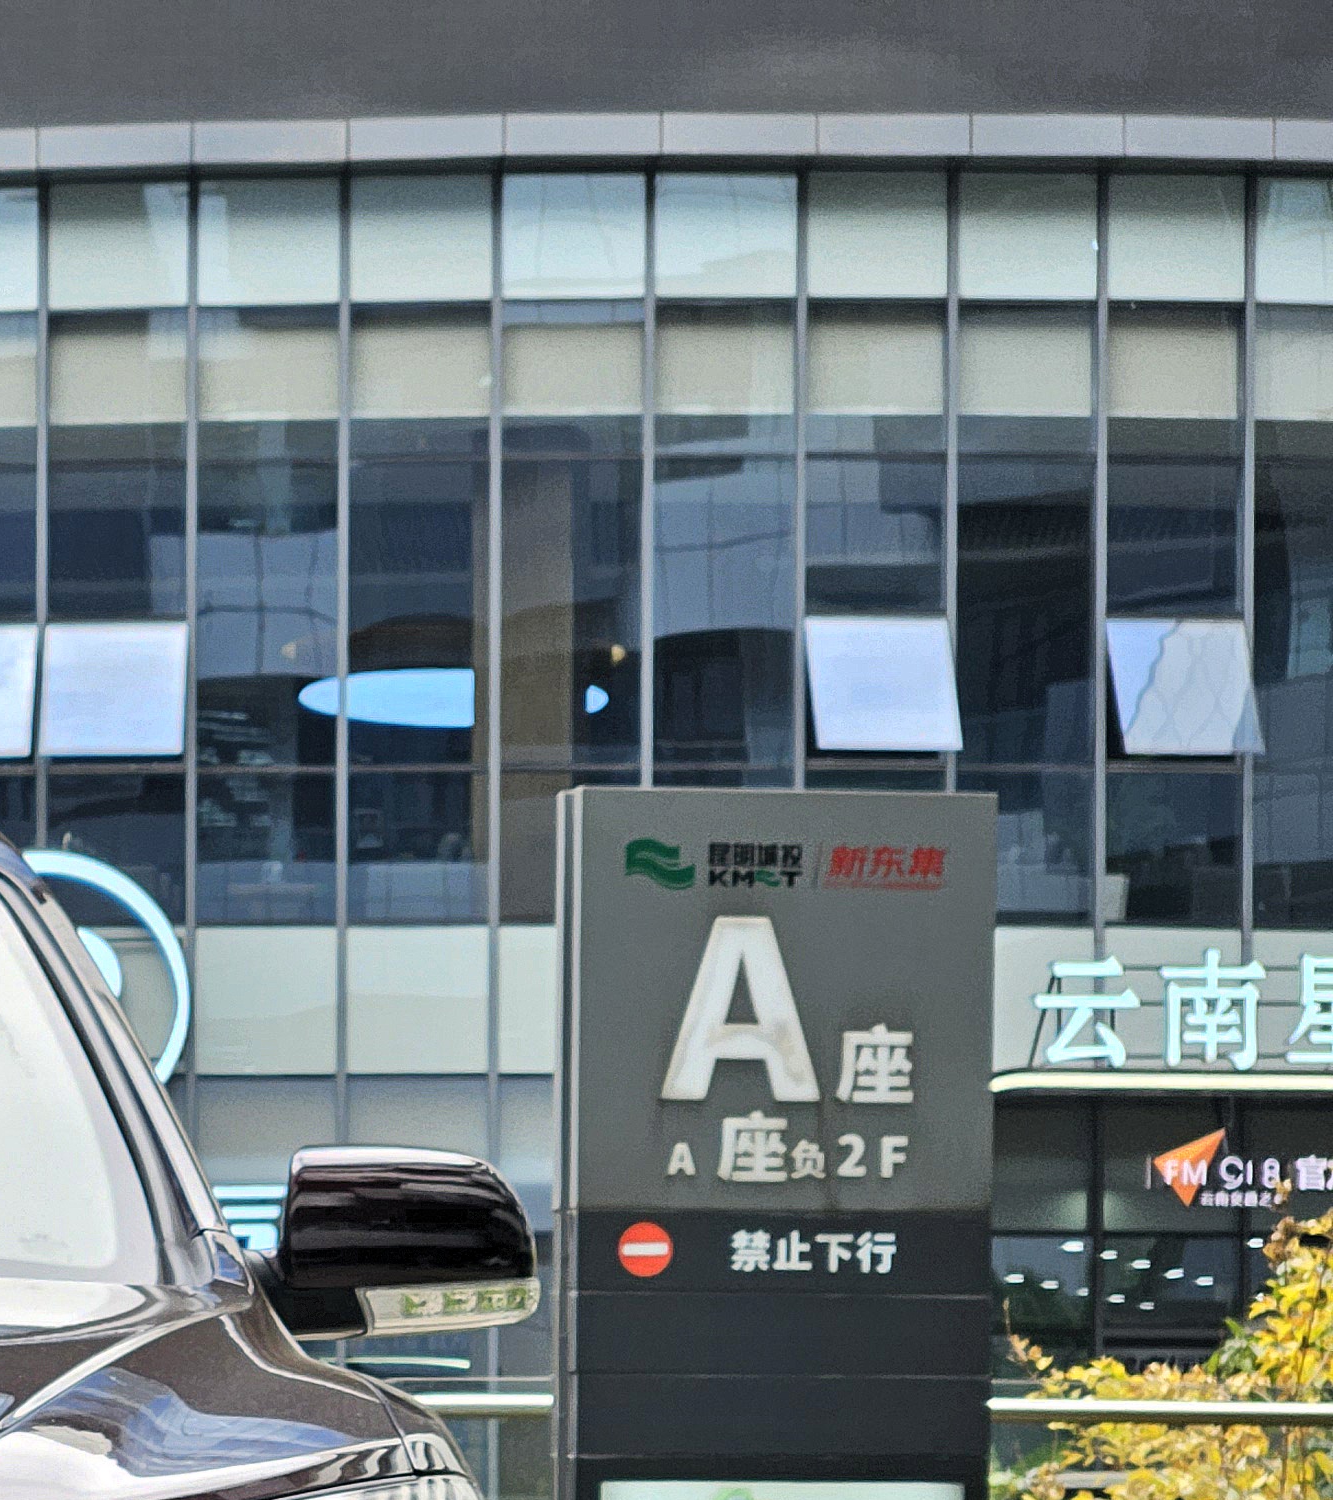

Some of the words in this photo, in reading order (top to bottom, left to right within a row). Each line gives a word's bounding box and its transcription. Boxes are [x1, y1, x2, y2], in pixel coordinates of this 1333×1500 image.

[1163, 1158, 1208, 1186] FM
[731, 1229, 897, 1274] 禁止下行
